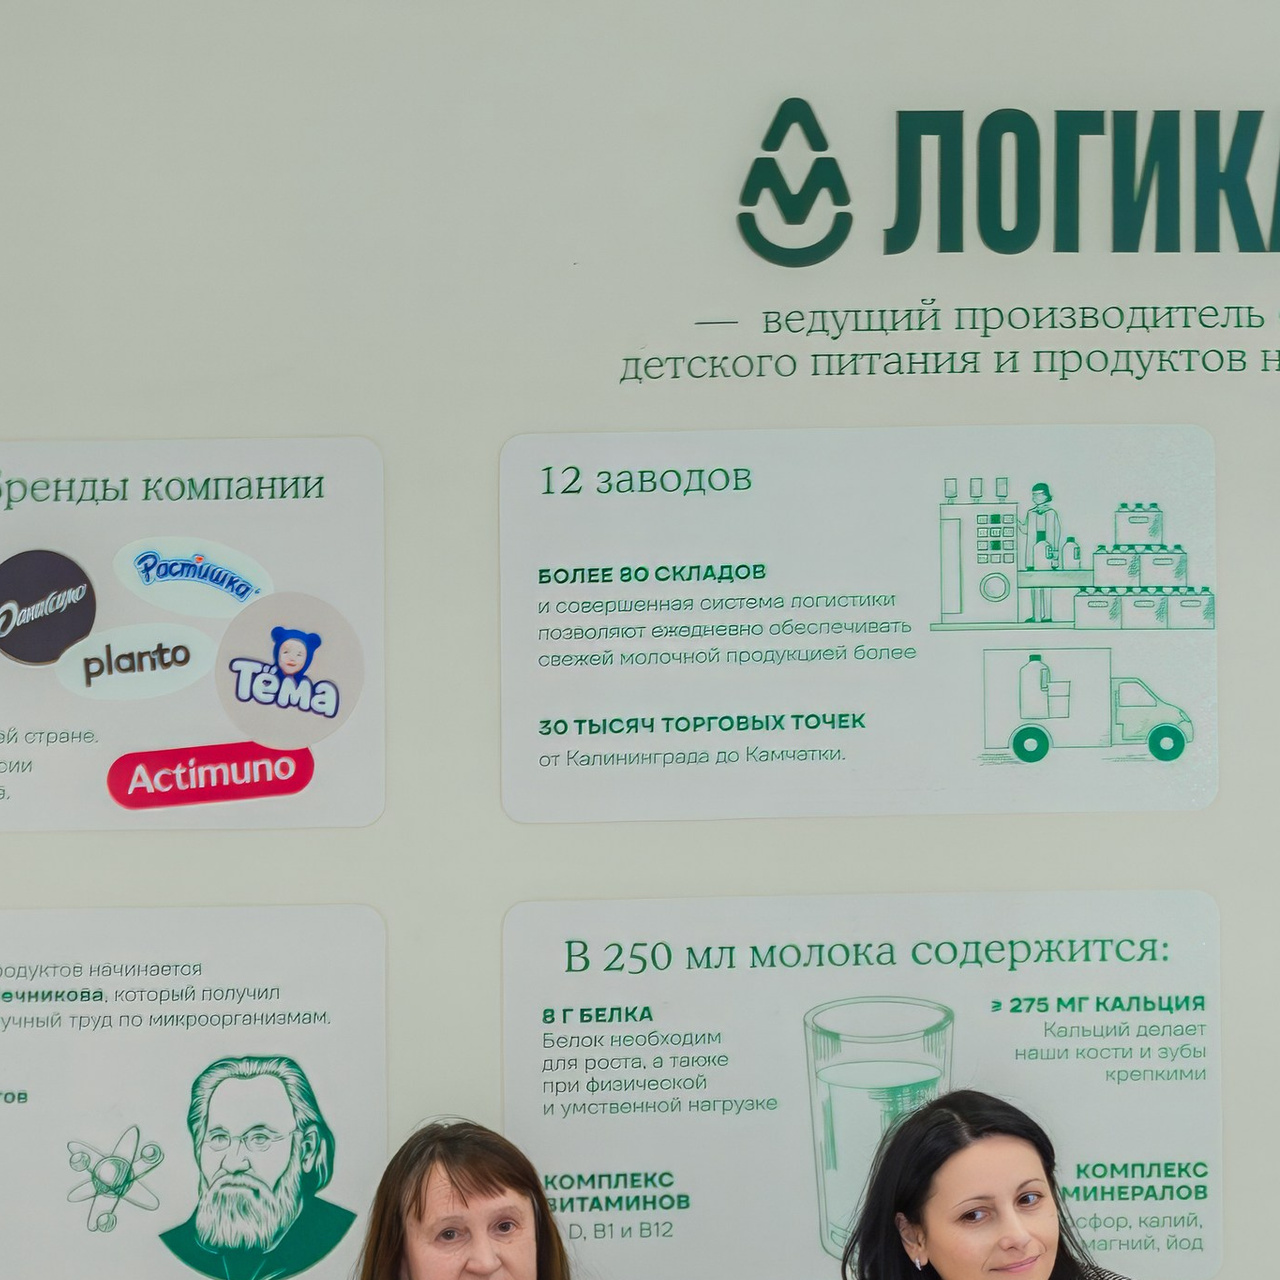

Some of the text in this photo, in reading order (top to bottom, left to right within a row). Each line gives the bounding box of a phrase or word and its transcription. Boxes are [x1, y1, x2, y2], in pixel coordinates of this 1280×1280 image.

[762, 297, 942, 341] ведущий
[954, 305, 1265, 338] производитель
[619, 354, 797, 385] детского
[810, 351, 981, 376] питания
[993, 350, 1020, 374] и
[1032, 349, 1247, 381] продуктов
[0, 469, 325, 511] ренды компании
[541, 465, 752, 497] 12 заводов
[538, 563, 767, 585] БОЛЕЕ 80 СКЛАДОВ
[538, 594, 896, 616] и совершенная система логистики
[538, 618, 912, 641] позволяют ежедневно обеспечивать
[84, 643, 191, 687] planto
[538, 644, 917, 668] свежей молочной продукцией более
[229, 657, 339, 718] Тёма
[538, 712, 866, 736] 30 ТЫСЯЧ ТОРГОВЫХ ТОЧЕК
[24, 730, 99, 746] стране.
[538, 745, 846, 768] от Калининграда до Камчатки.
[127, 756, 296, 795] Actimuno
[564, 938, 1169, 975] В 250 мл молока содержится:
[0, 962, 202, 982] одуктов начинается
[114, 985, 280, 1006] который получил
[1009, 995, 1206, 1015] 275 МГ КАЛЬЦИЯ
[69, 1015, 113, 1032] труд
[118, 1014, 143, 1028] по
[149, 1011, 331, 1031] микроорганизмам.
[542, 1005, 654, 1025] 8 Г БЕЛКА
[542, 1030, 722, 1049] Белок необходим
[1044, 1021, 1207, 1039] Кальций делает
[1015, 1043, 1206, 1063] наши кости и зубы
[541, 1054, 729, 1074] для роста, а также
[543, 1073, 707, 1097] при физической
[1105, 1068, 1207, 1086] крепкими
[543, 1096, 778, 1120] и умственной нагрузке
[544, 1171, 675, 1191] КОМПЛЕКС
[1076, 1161, 1209, 1180] КОМПЛЕКС
[1061, 1185, 1208, 1201] МИНЕРАЛОВ
[548, 1195, 691, 1213] ВИТАМИНОВ
[1138, 1213, 1203, 1229] калий,
[620, 1226, 633, 1239] и
[1167, 1234, 1204, 1251] йод
